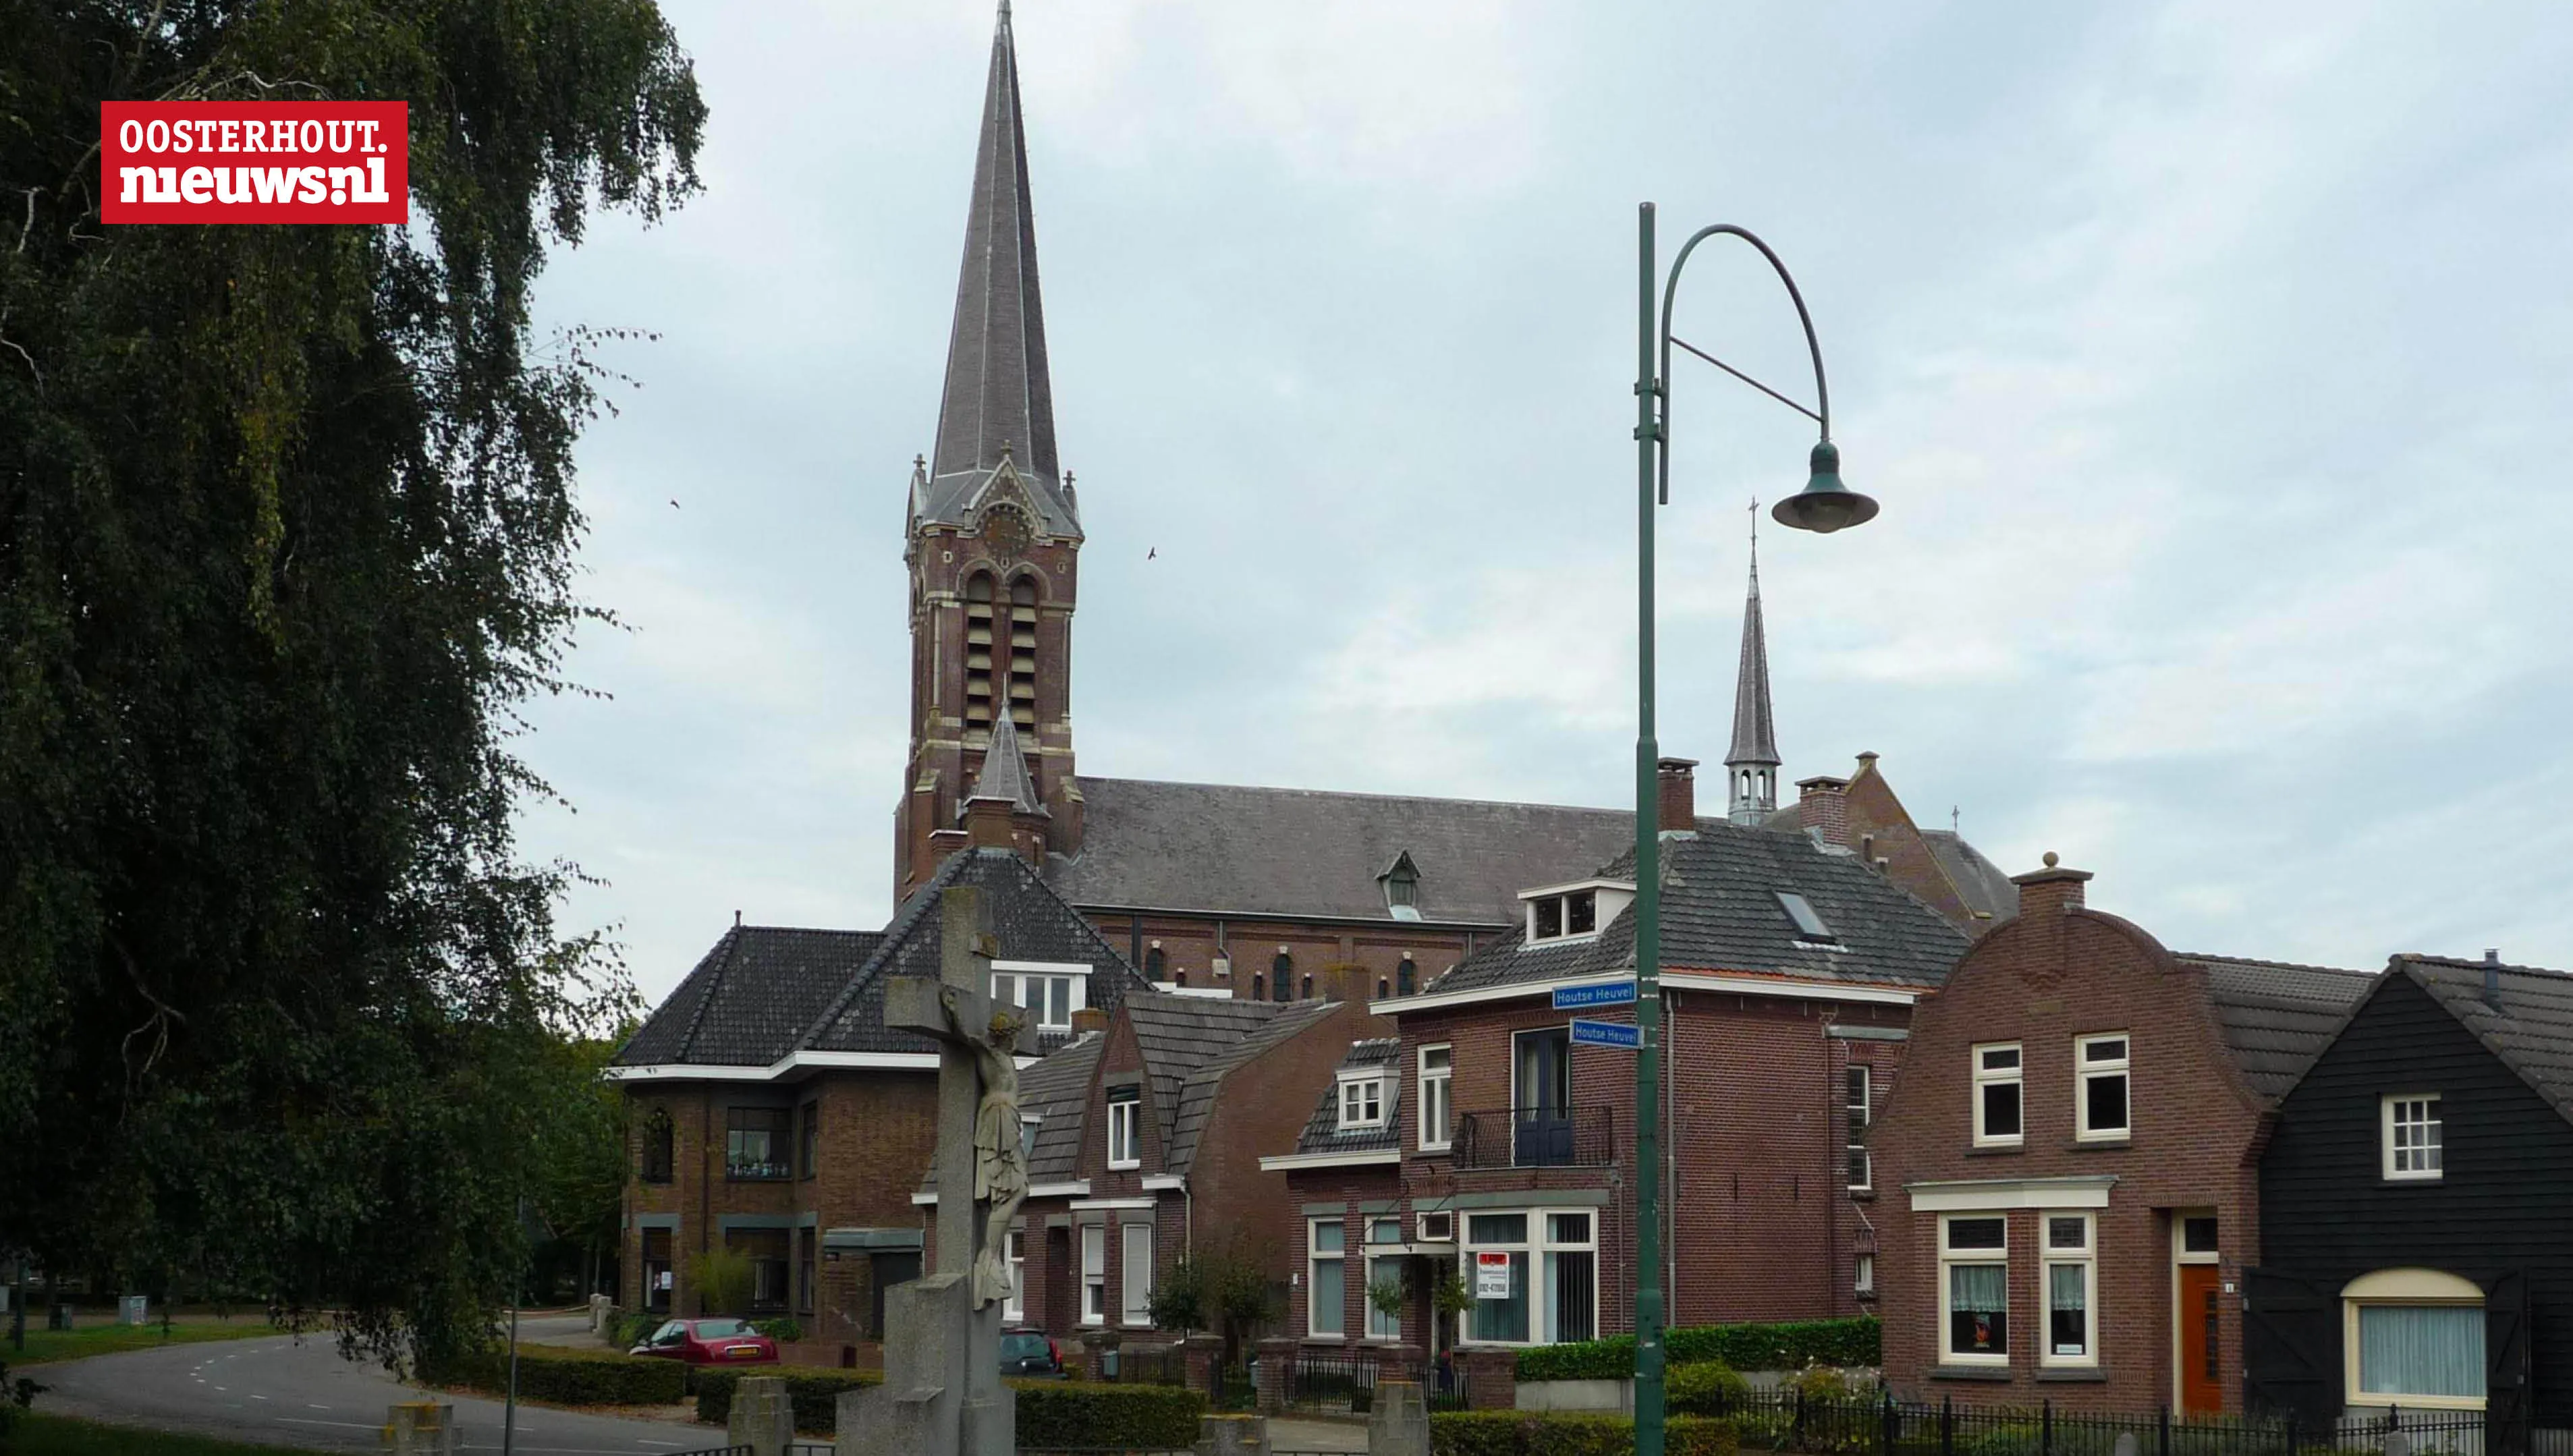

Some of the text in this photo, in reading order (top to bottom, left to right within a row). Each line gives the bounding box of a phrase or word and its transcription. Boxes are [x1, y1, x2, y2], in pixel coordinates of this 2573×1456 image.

[1557, 986, 1632, 1004] Houtse Heuvel
[1576, 1026, 1636, 1042] Houtse Heuvel
